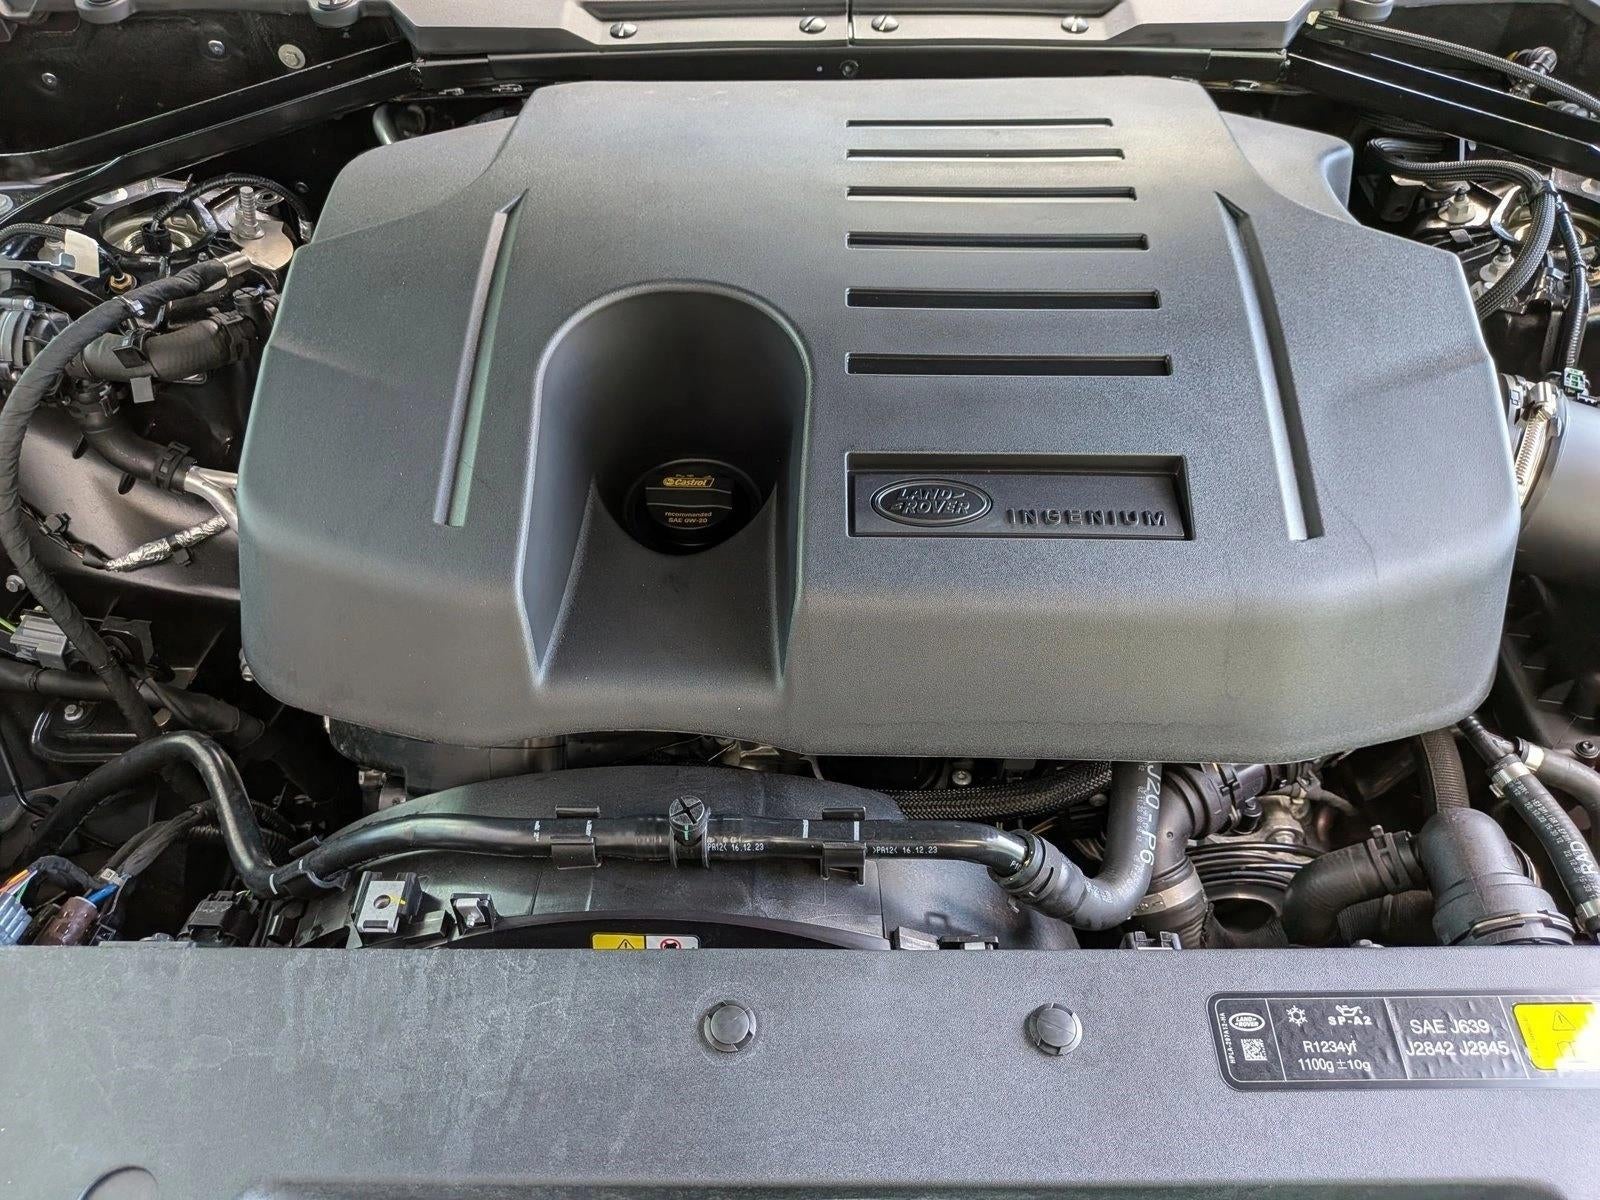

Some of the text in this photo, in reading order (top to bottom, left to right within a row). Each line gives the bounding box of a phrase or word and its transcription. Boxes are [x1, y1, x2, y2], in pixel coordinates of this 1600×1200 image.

[675, 479, 707, 487] Castrol
[899, 488, 958, 499] LAND
[903, 500, 971, 514] ROVER
[1006, 507, 1168, 527] INGENIUM
[1140, 764, 1161, 866] J20-P6
[731, 843, 764, 852] 16.12.23
[903, 846, 938, 855] 16.12.23
[1570, 841, 1598, 875] RAD
[1328, 1015, 1373, 1026] SP-A2
[1410, 1019, 1490, 1034] SAE J639
[1302, 1040, 1358, 1056] R1234yf
[1405, 1040, 1510, 1056] J2842 J2845
[1298, 1057, 1372, 1074] 1100g ±10g
